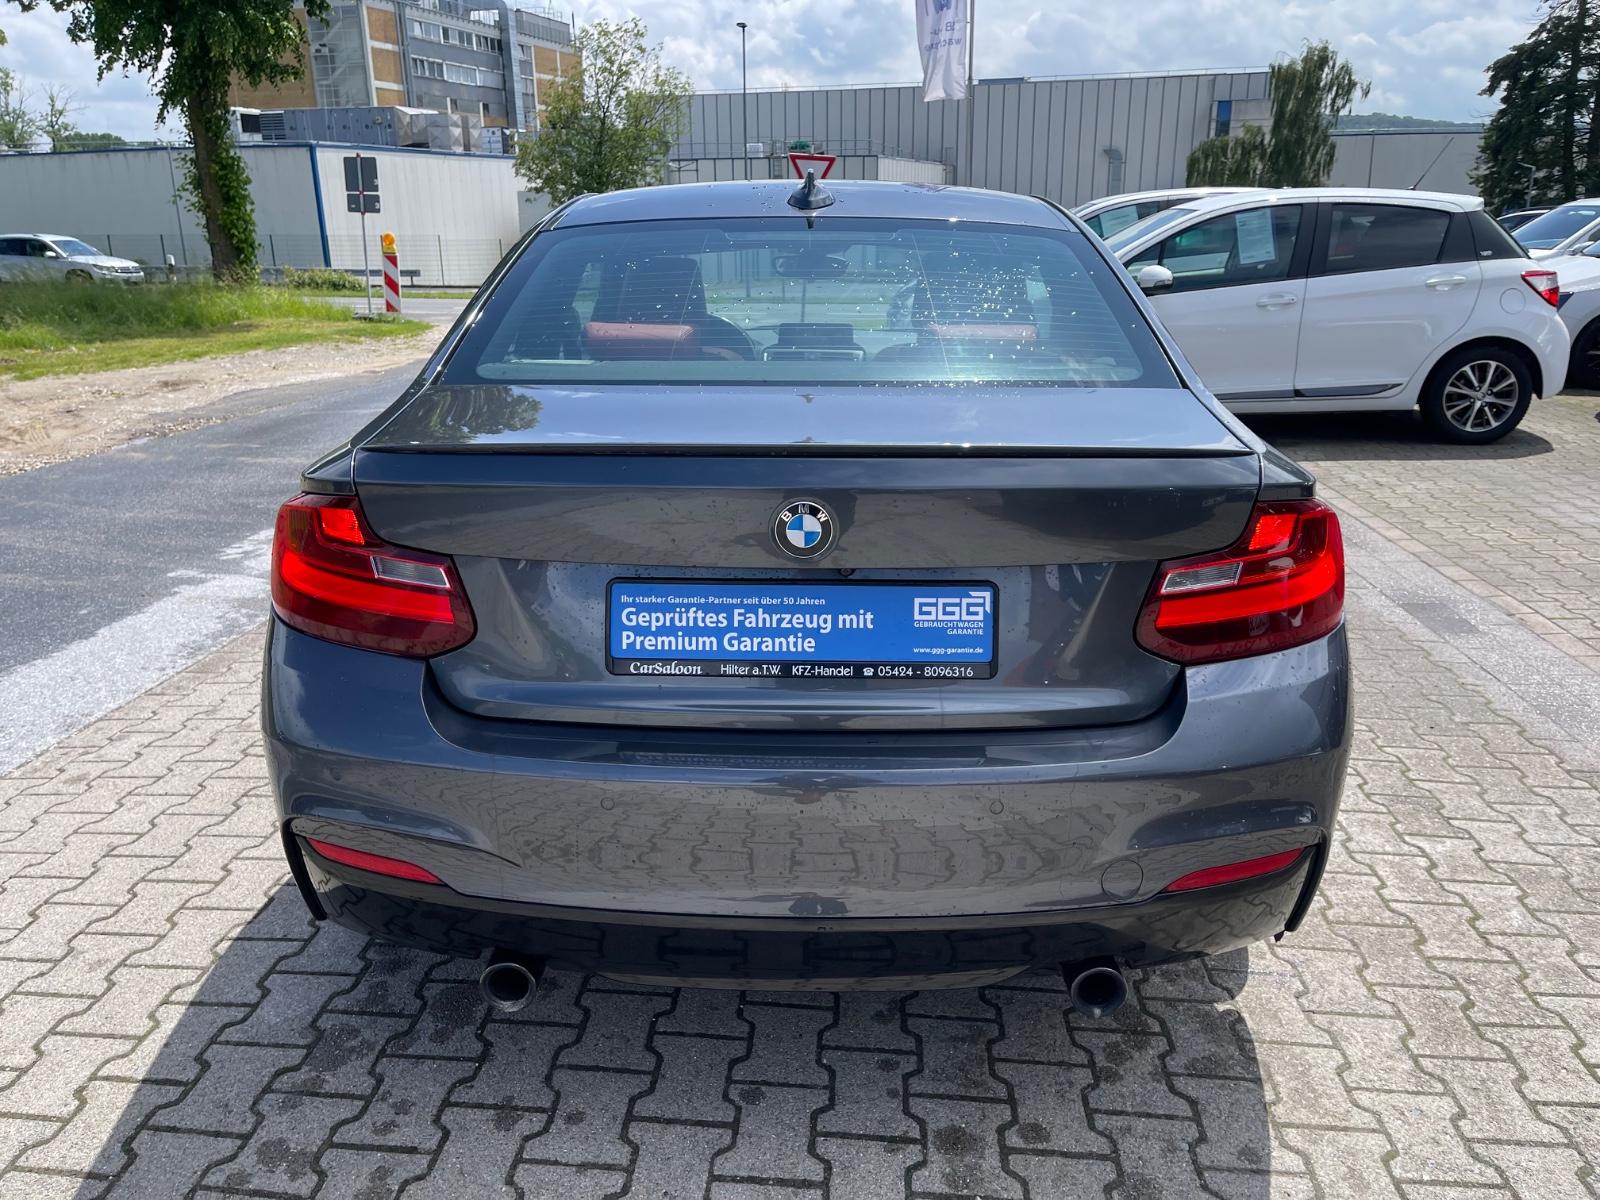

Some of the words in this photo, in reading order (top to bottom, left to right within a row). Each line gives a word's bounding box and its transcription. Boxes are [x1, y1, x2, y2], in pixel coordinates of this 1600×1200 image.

[781, 504, 828, 522] BMW
[621, 595, 634, 603] Ihr
[635, 595, 665, 604] starker
[667, 595, 741, 605] Garantie-Partner
[743, 596, 759, 605] seit
[761, 596, 781, 605] über
[783, 597, 794, 605] 50
[795, 597, 825, 606] Jahren
[914, 597, 984, 620] GGG
[621, 607, 728, 631] Geprüftes
[733, 608, 832, 634] Fahrzeug
[838, 609, 874, 629] mit
[622, 631, 718, 651] Premium
[723, 632, 816, 652] Garantie
[629, 660, 702, 675] CarSaloon
[720, 664, 750, 675] Hilter
[792, 665, 853, 676] KFZ-Handel
[878, 666, 913, 677] 05424
[924, 666, 974, 677] 8096316
